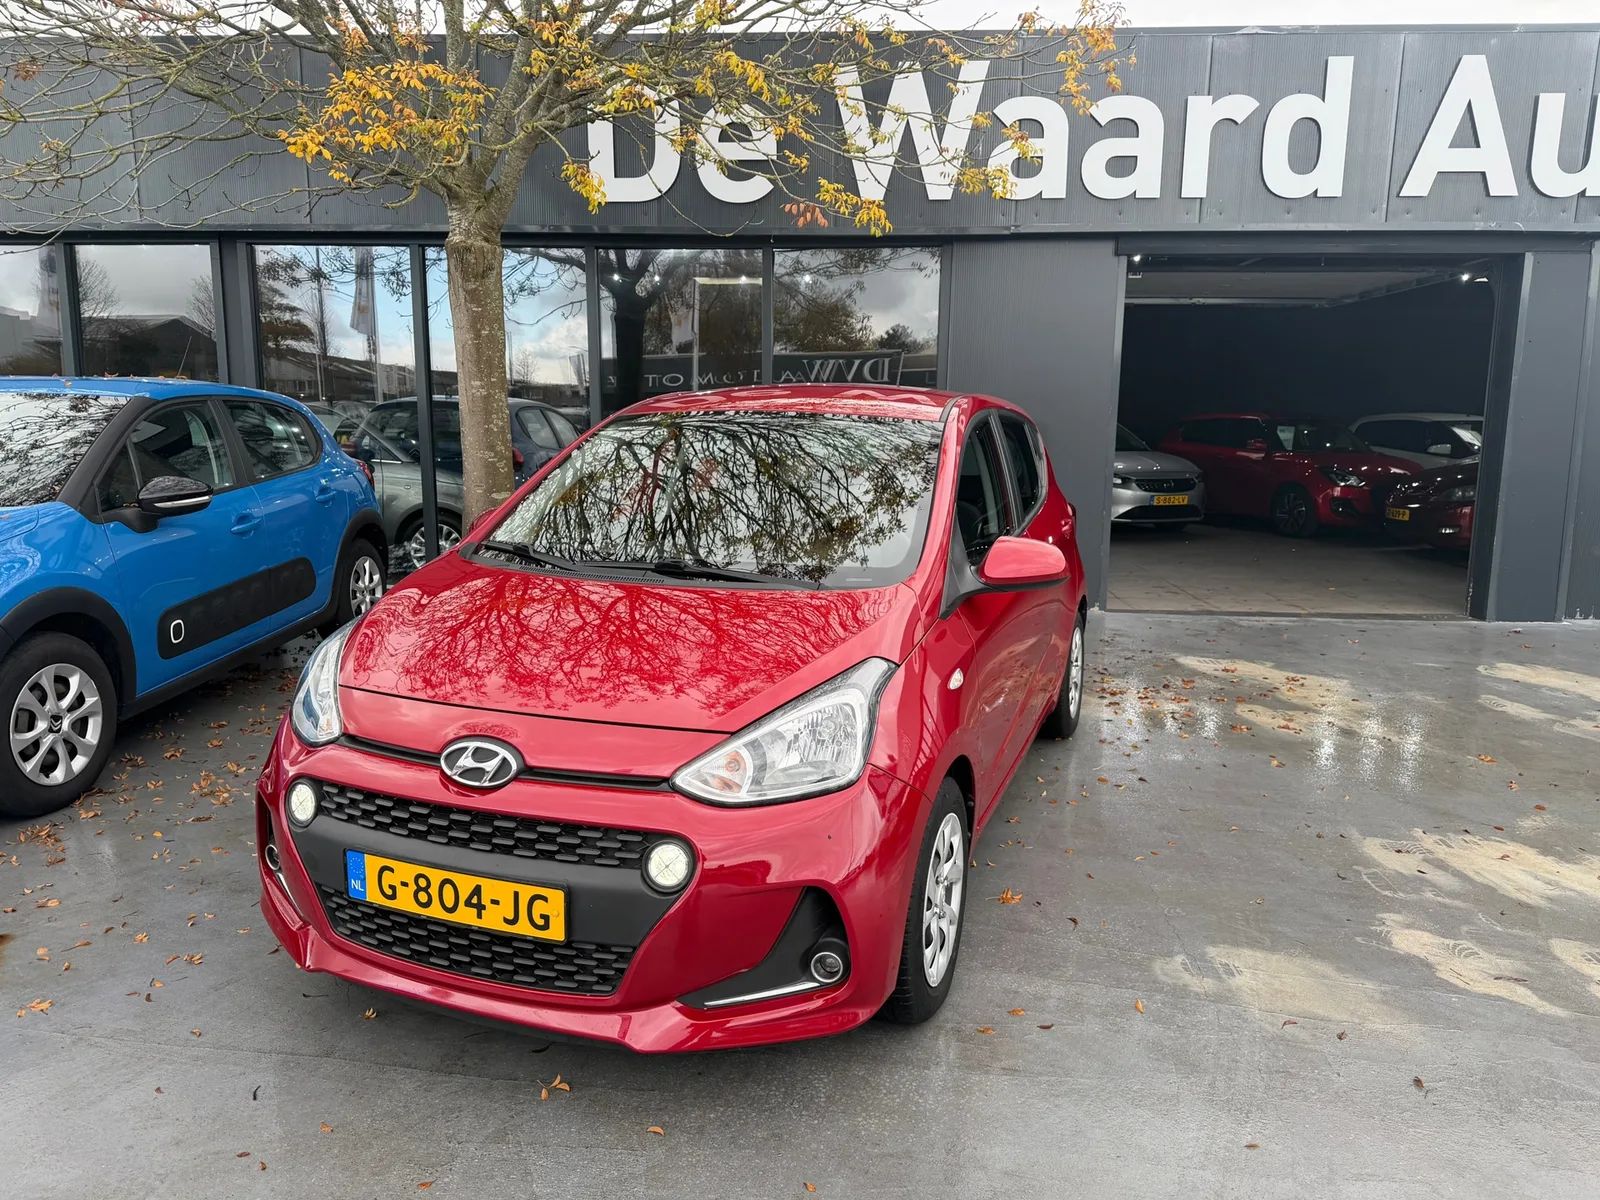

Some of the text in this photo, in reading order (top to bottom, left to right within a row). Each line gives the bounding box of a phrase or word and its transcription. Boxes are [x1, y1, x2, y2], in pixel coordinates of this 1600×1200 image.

[587, 54, 1600, 203] De Waard Au
[1155, 496, 1186, 505] S-882-LV
[351, 864, 551, 932] NL G-804-JG
